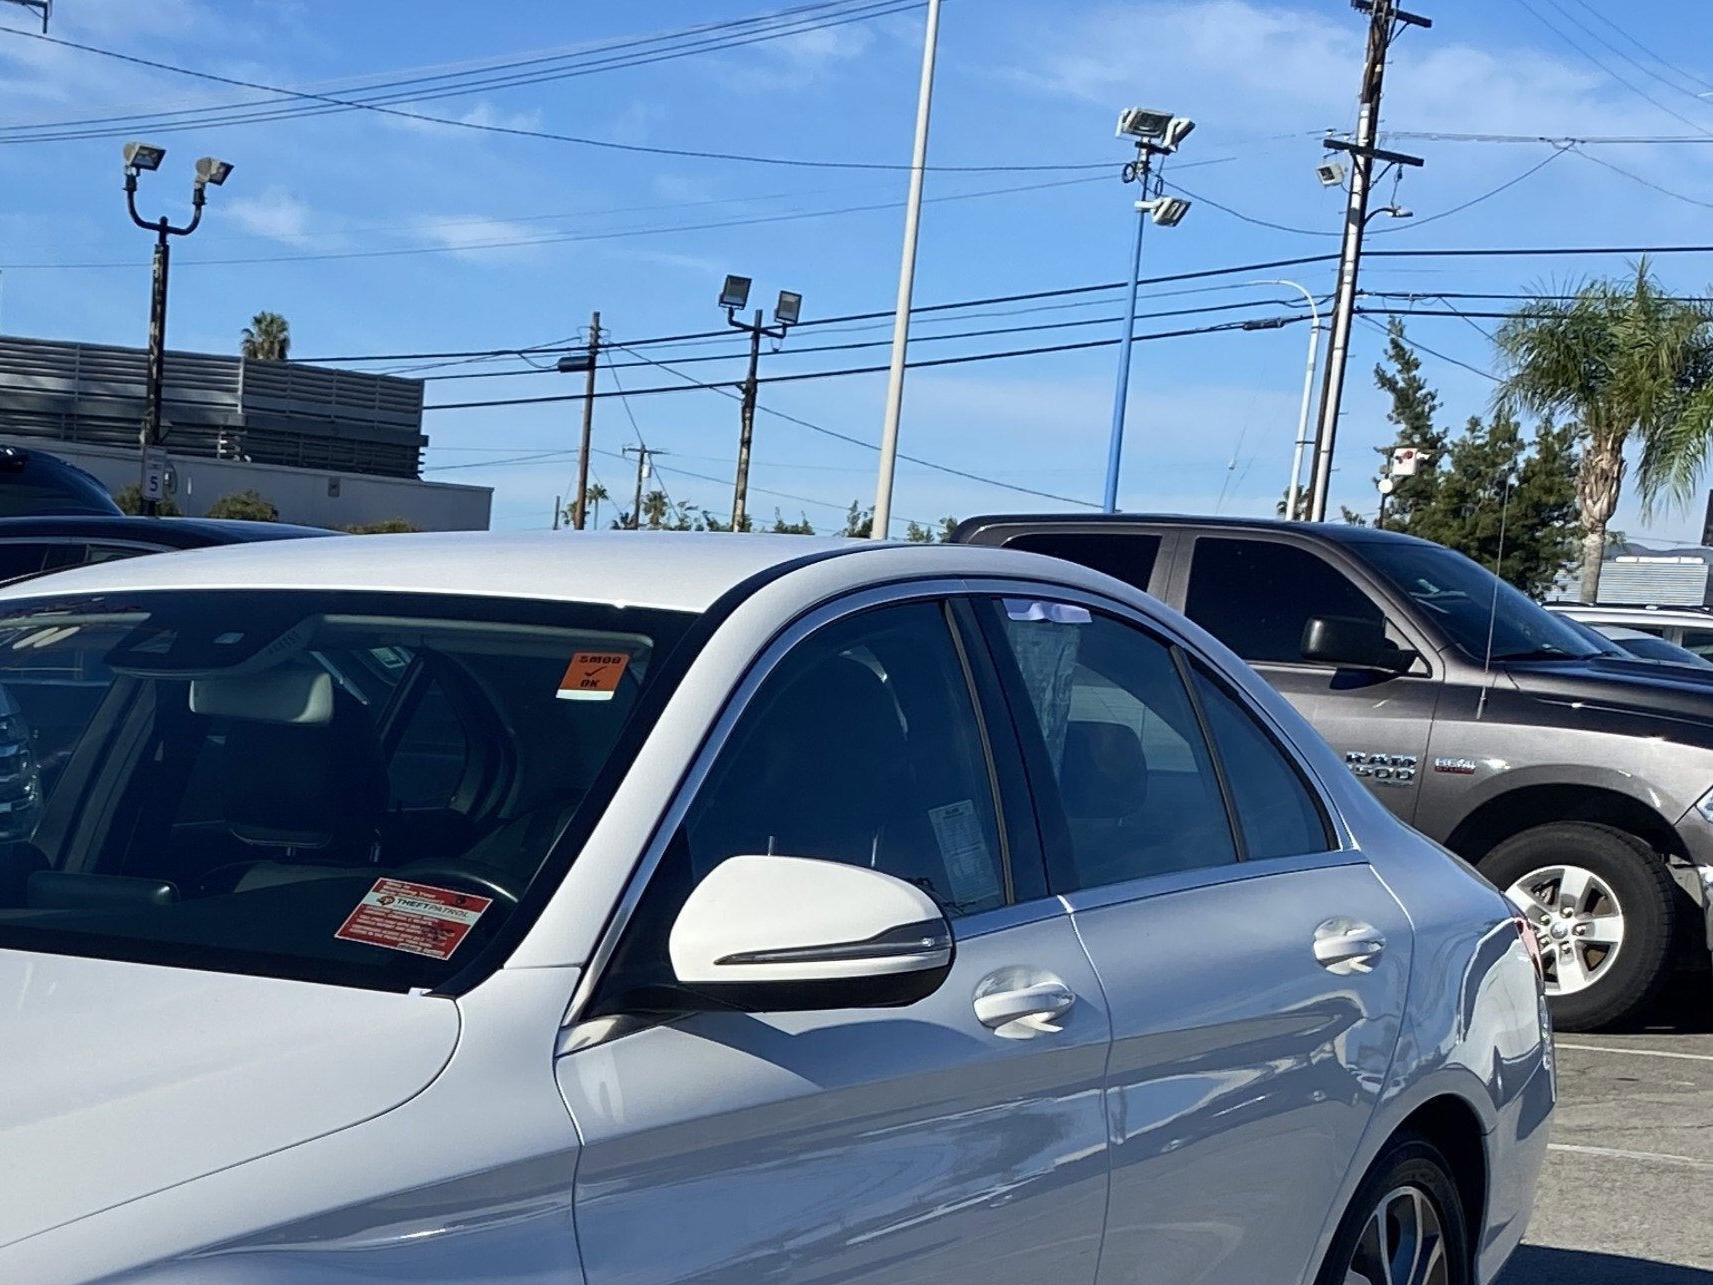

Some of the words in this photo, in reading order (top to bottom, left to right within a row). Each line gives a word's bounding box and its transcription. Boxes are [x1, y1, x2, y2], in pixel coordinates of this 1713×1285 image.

[149, 475, 159, 492] 5
[579, 655, 622, 664] SMOG
[580, 679, 599, 688] OK
[1346, 751, 1417, 767] RAM
